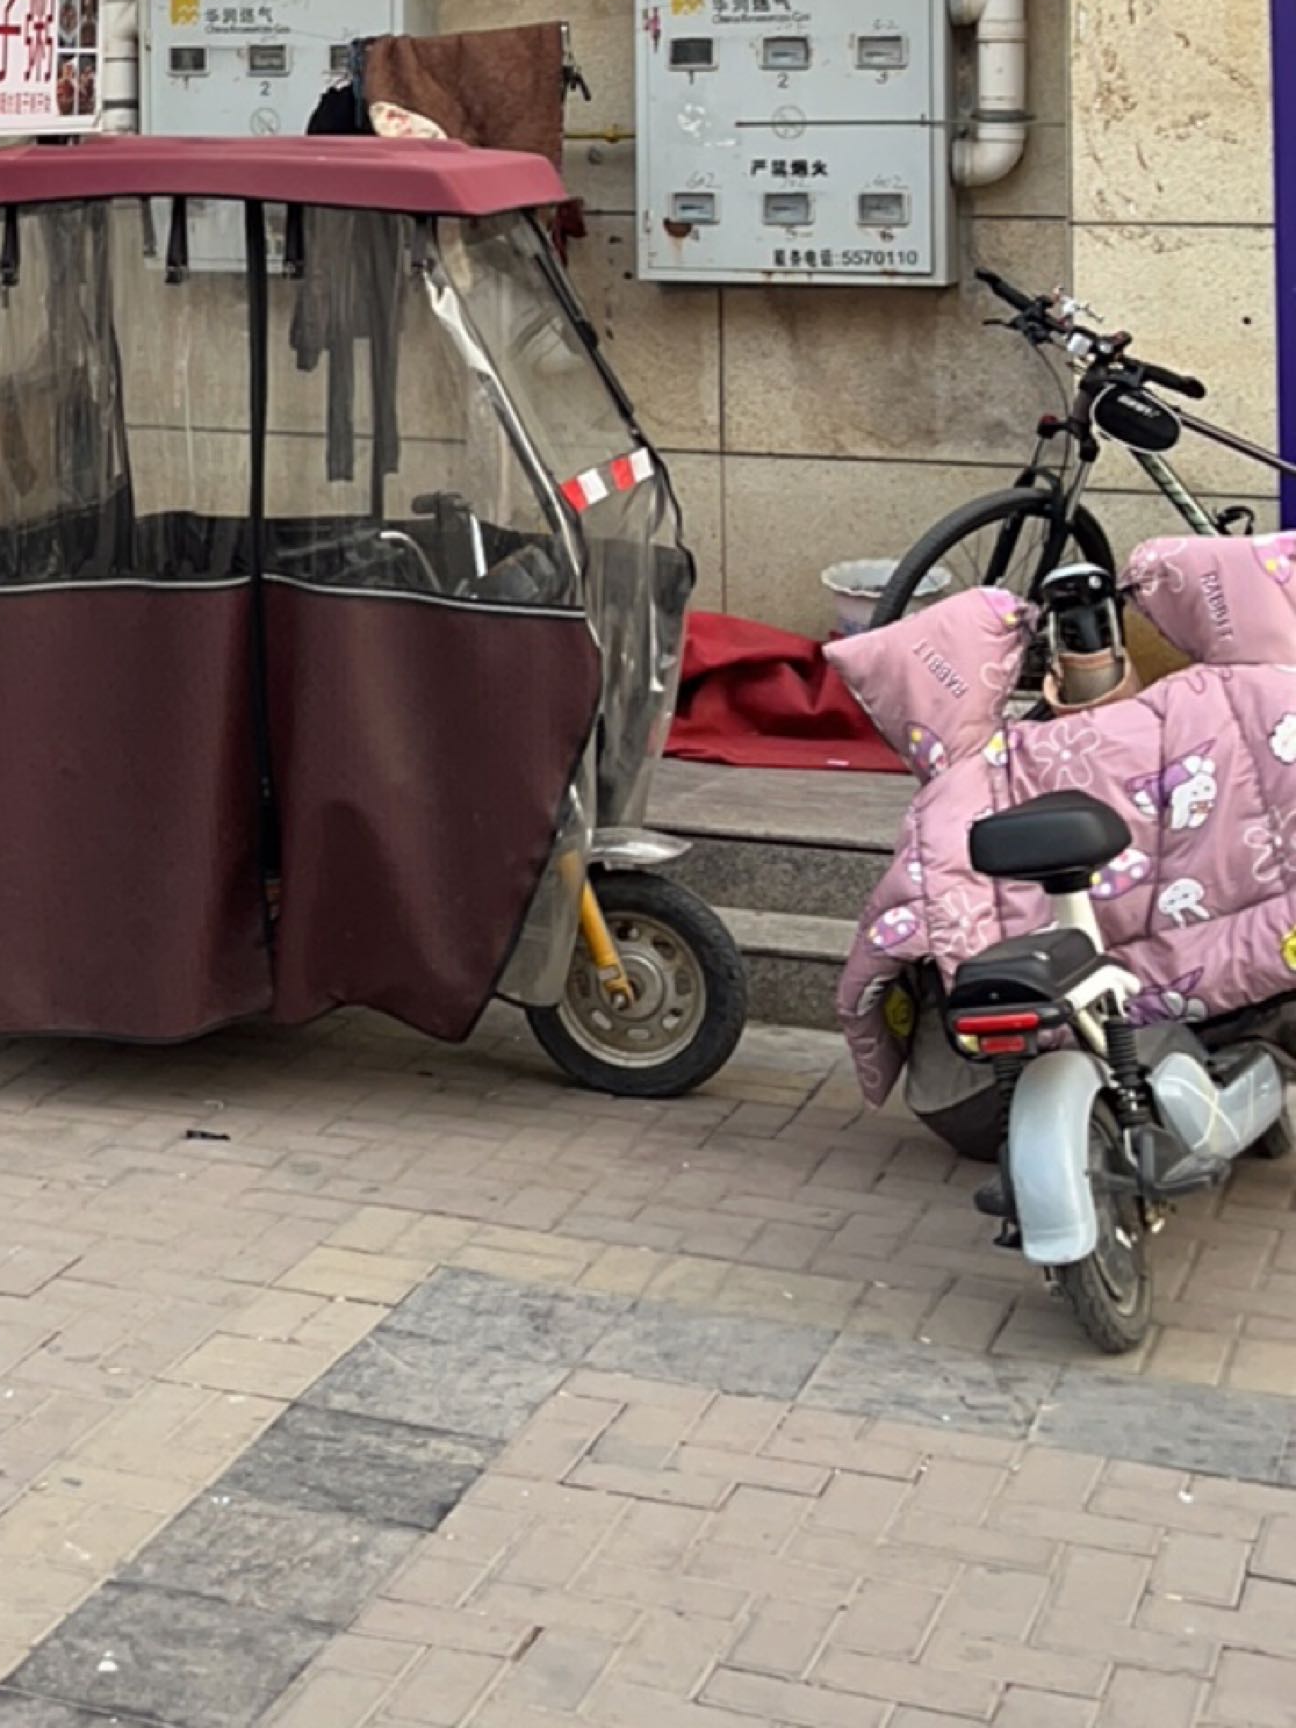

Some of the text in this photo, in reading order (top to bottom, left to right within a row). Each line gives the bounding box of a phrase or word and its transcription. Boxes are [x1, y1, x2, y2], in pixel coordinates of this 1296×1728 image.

[260, 81, 270, 97] 2
[777, 73, 788, 89] 2
[1198, 573, 1234, 642] RABBIT
[912, 641, 969, 700] RABBIT
